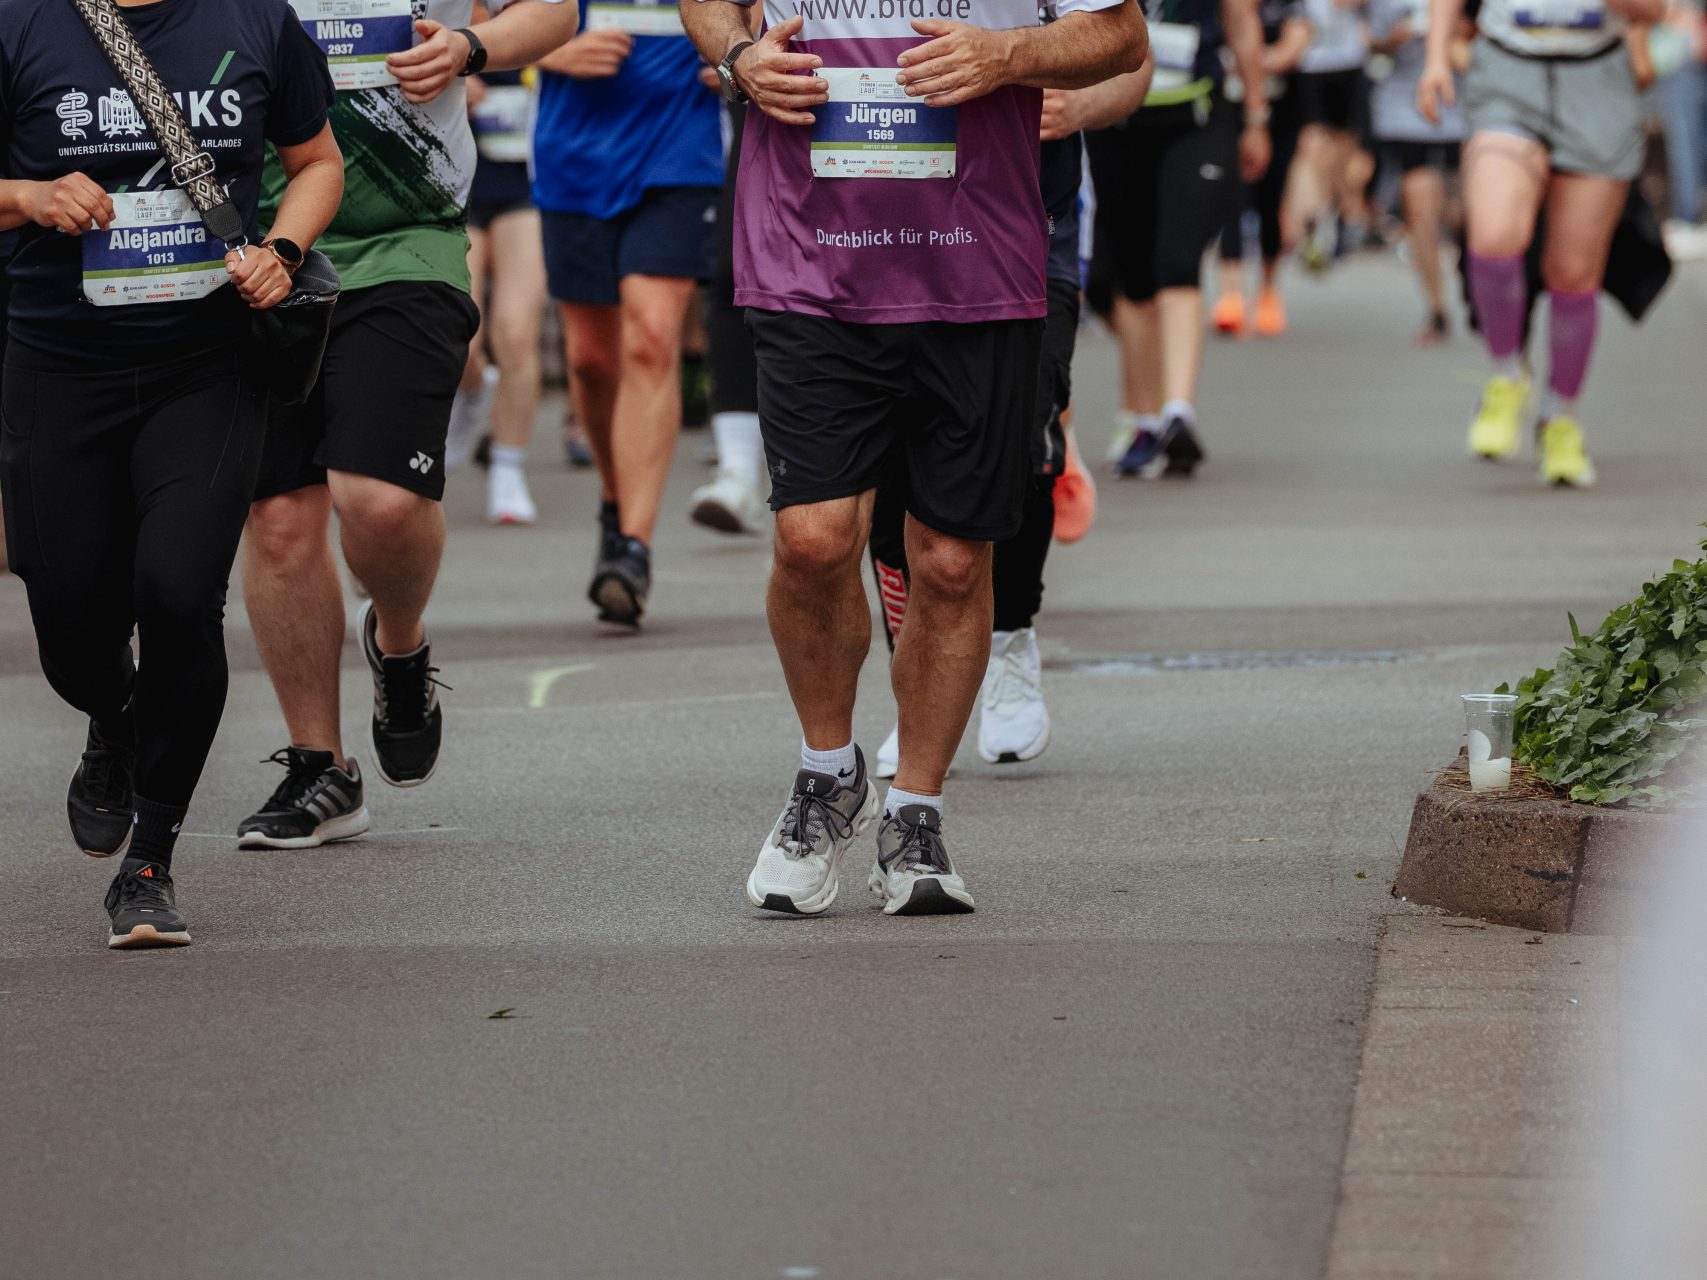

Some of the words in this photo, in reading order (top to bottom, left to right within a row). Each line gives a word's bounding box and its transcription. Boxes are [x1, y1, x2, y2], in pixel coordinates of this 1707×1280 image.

[316, 20, 364, 40] Mike
[327, 43, 354, 55] 2937
[845, 104, 917, 128] Jürgen
[866, 129, 895, 141] 1569
[58, 142, 160, 157] UNIVERSITÄTSKLINIKU
[201, 138, 242, 148] ARLANDES
[108, 224, 206, 253] Alejandra
[816, 228, 894, 248] Durchblick
[899, 228, 923, 245] für
[929, 227, 978, 246] Profis.
[146, 252, 175, 265] 1013
